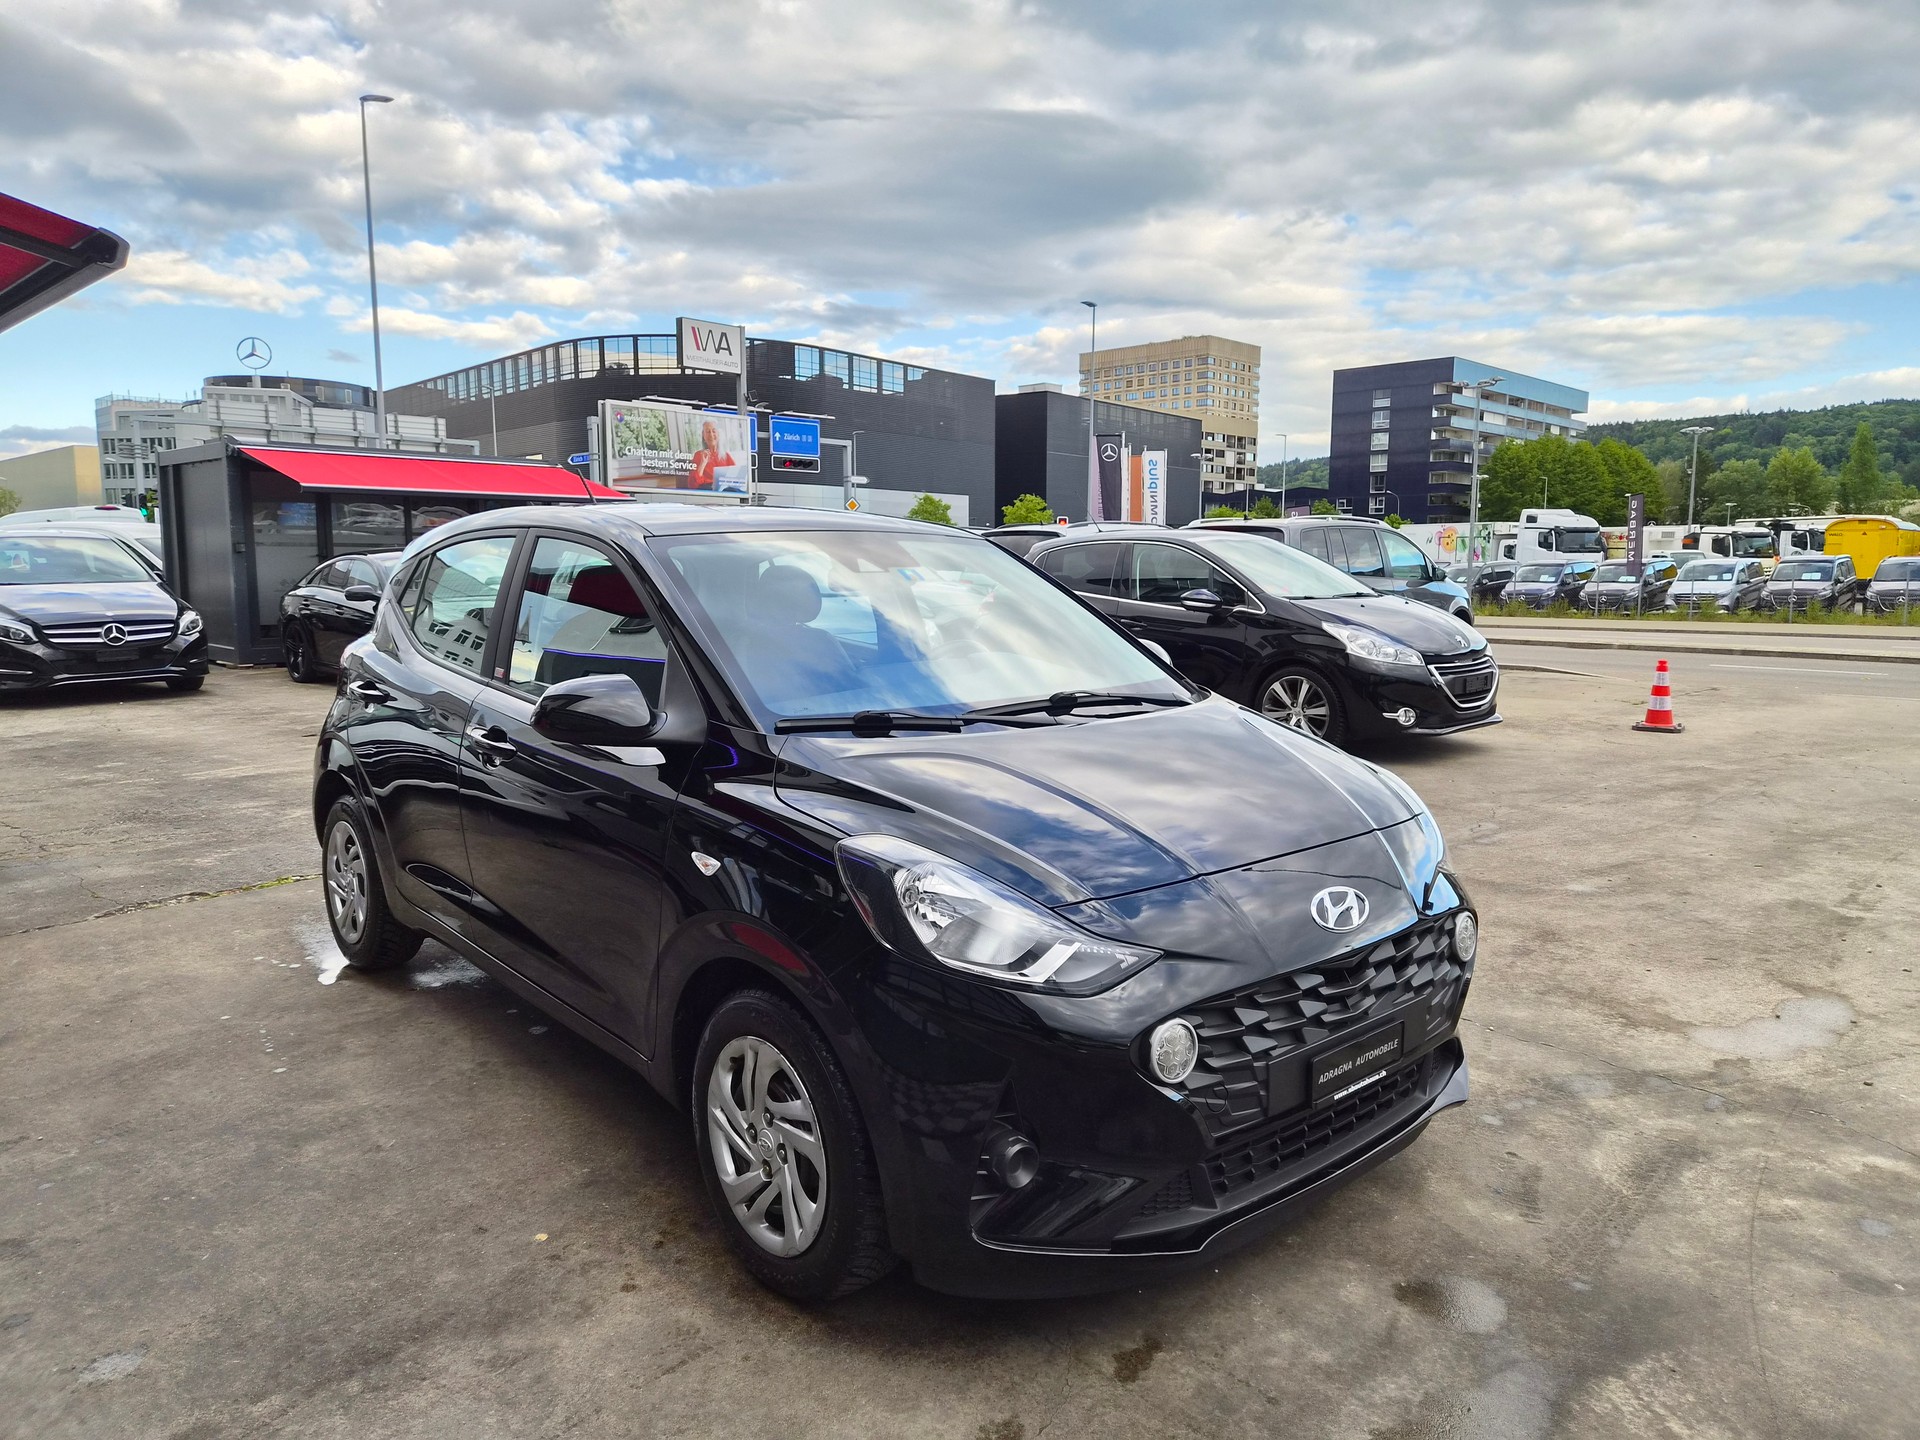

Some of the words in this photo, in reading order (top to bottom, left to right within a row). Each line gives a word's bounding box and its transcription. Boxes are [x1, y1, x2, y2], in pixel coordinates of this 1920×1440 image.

[784, 433, 800, 441] Zürich
[625, 446, 658, 458] Chatten
[660, 449, 674, 459] mit
[675, 450, 692, 460] dem
[641, 457, 668, 468] besten
[669, 459, 697, 470] Service
[1318, 1061, 1353, 1085] ADRAGNA
[1355, 1038, 1399, 1067] AUTOMOBILE
